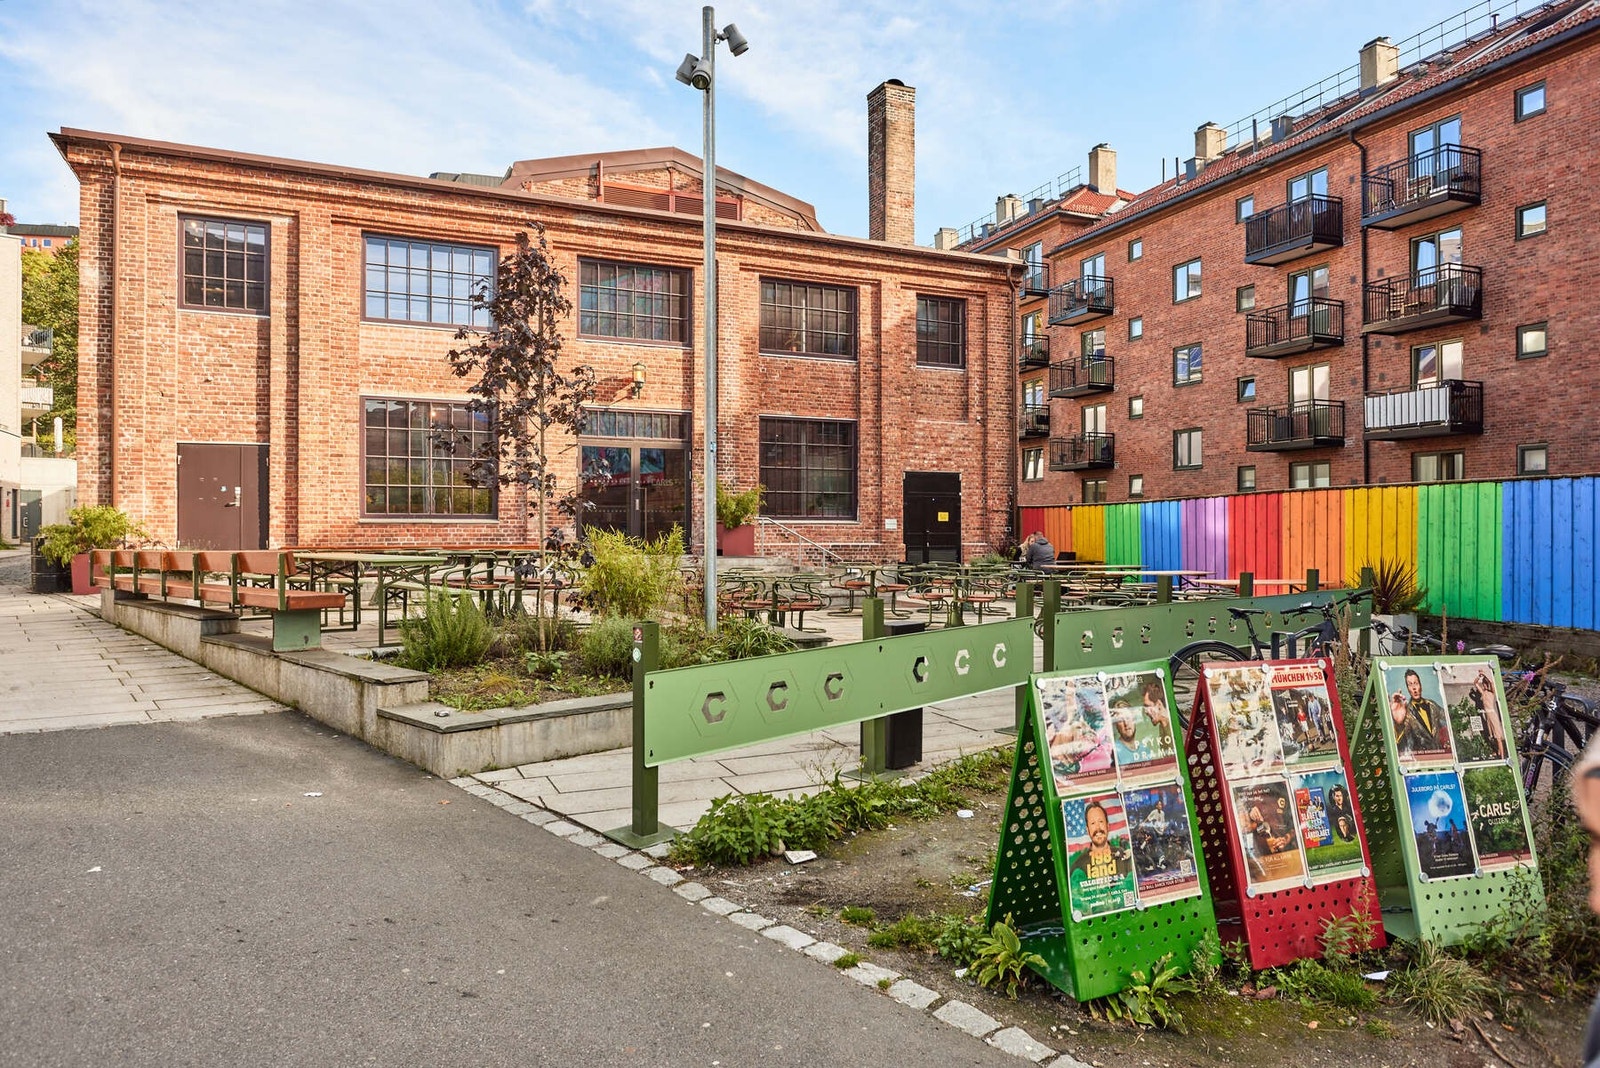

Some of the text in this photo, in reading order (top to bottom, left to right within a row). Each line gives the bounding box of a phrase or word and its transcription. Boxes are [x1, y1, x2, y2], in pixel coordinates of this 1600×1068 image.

[1272, 671, 1323, 683] MÜNCHEN 1958
[1134, 735, 1171, 750] PSYKO
[1133, 747, 1174, 761] DRAMA
[1480, 802, 1511, 817] CARLS
[1087, 859, 1117, 879] land
